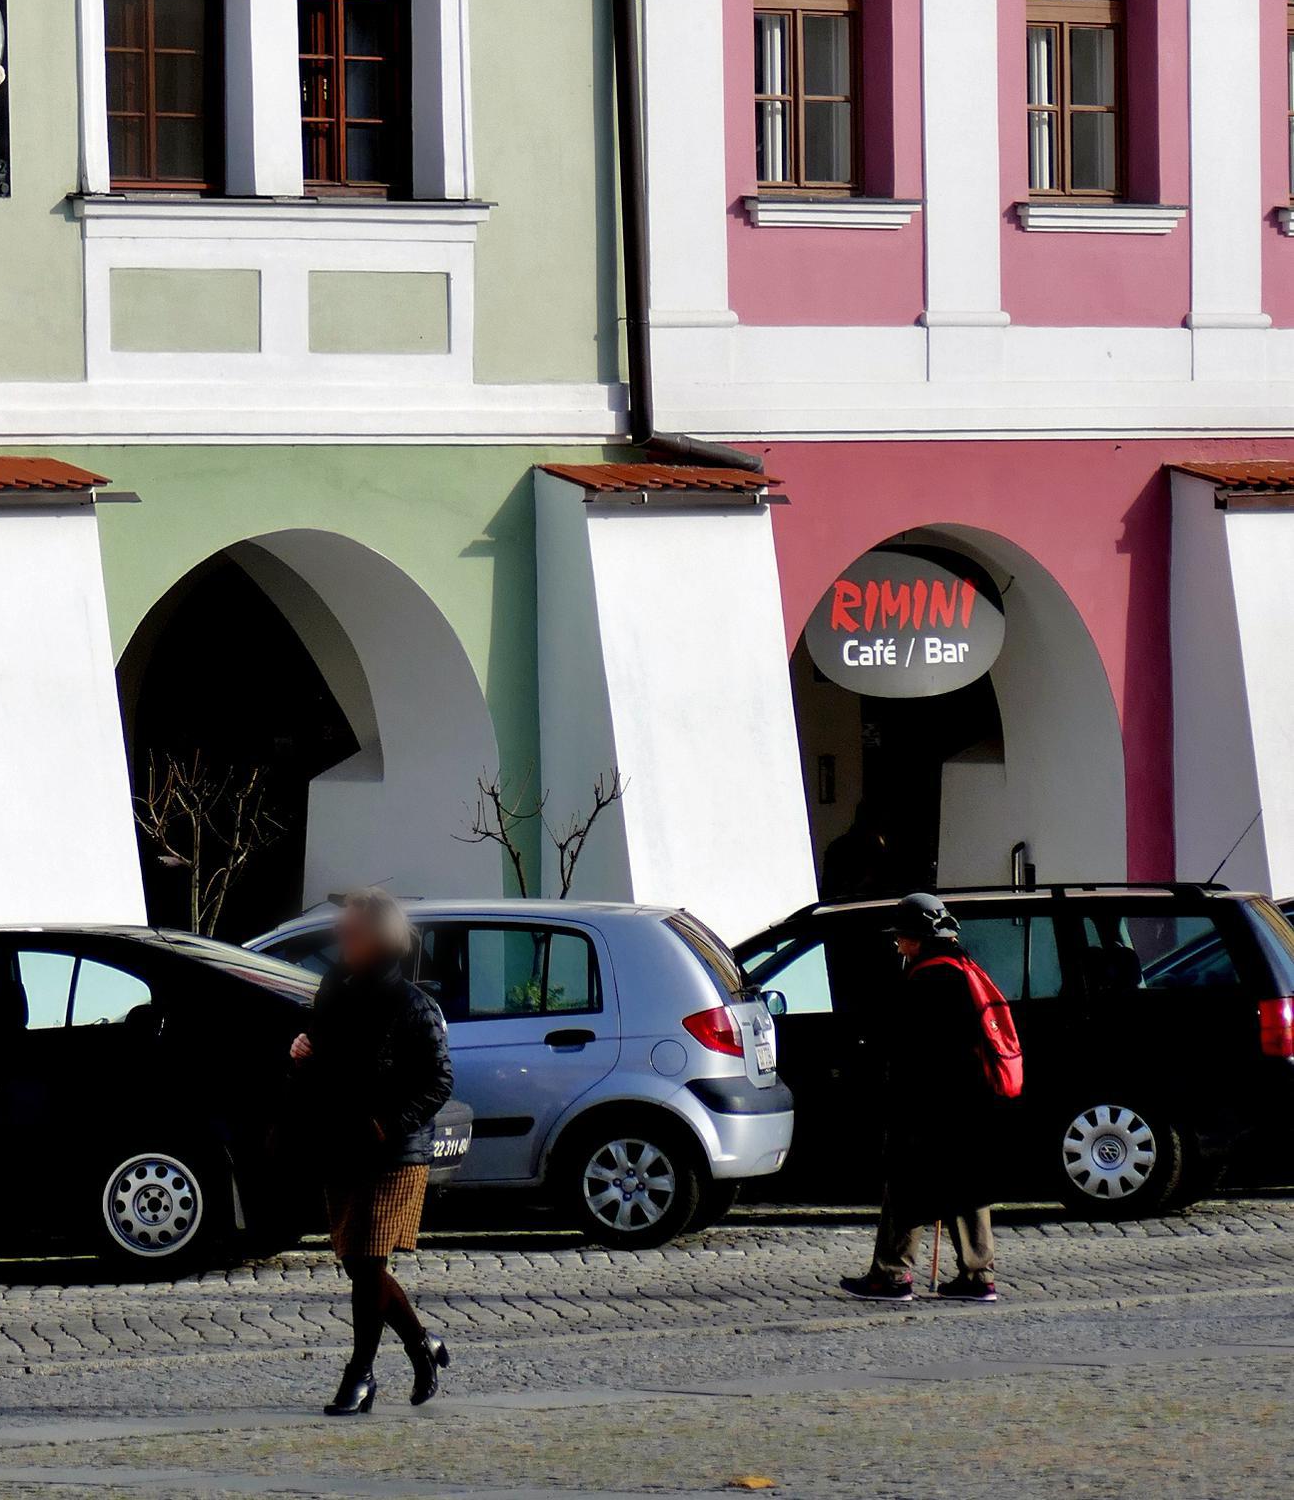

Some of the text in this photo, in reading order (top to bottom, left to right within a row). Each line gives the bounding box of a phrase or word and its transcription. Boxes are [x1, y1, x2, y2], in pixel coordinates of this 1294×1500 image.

[831, 579, 976, 633] RIMINI
[842, 638, 897, 667] Café
[924, 637, 970, 664] Bar
